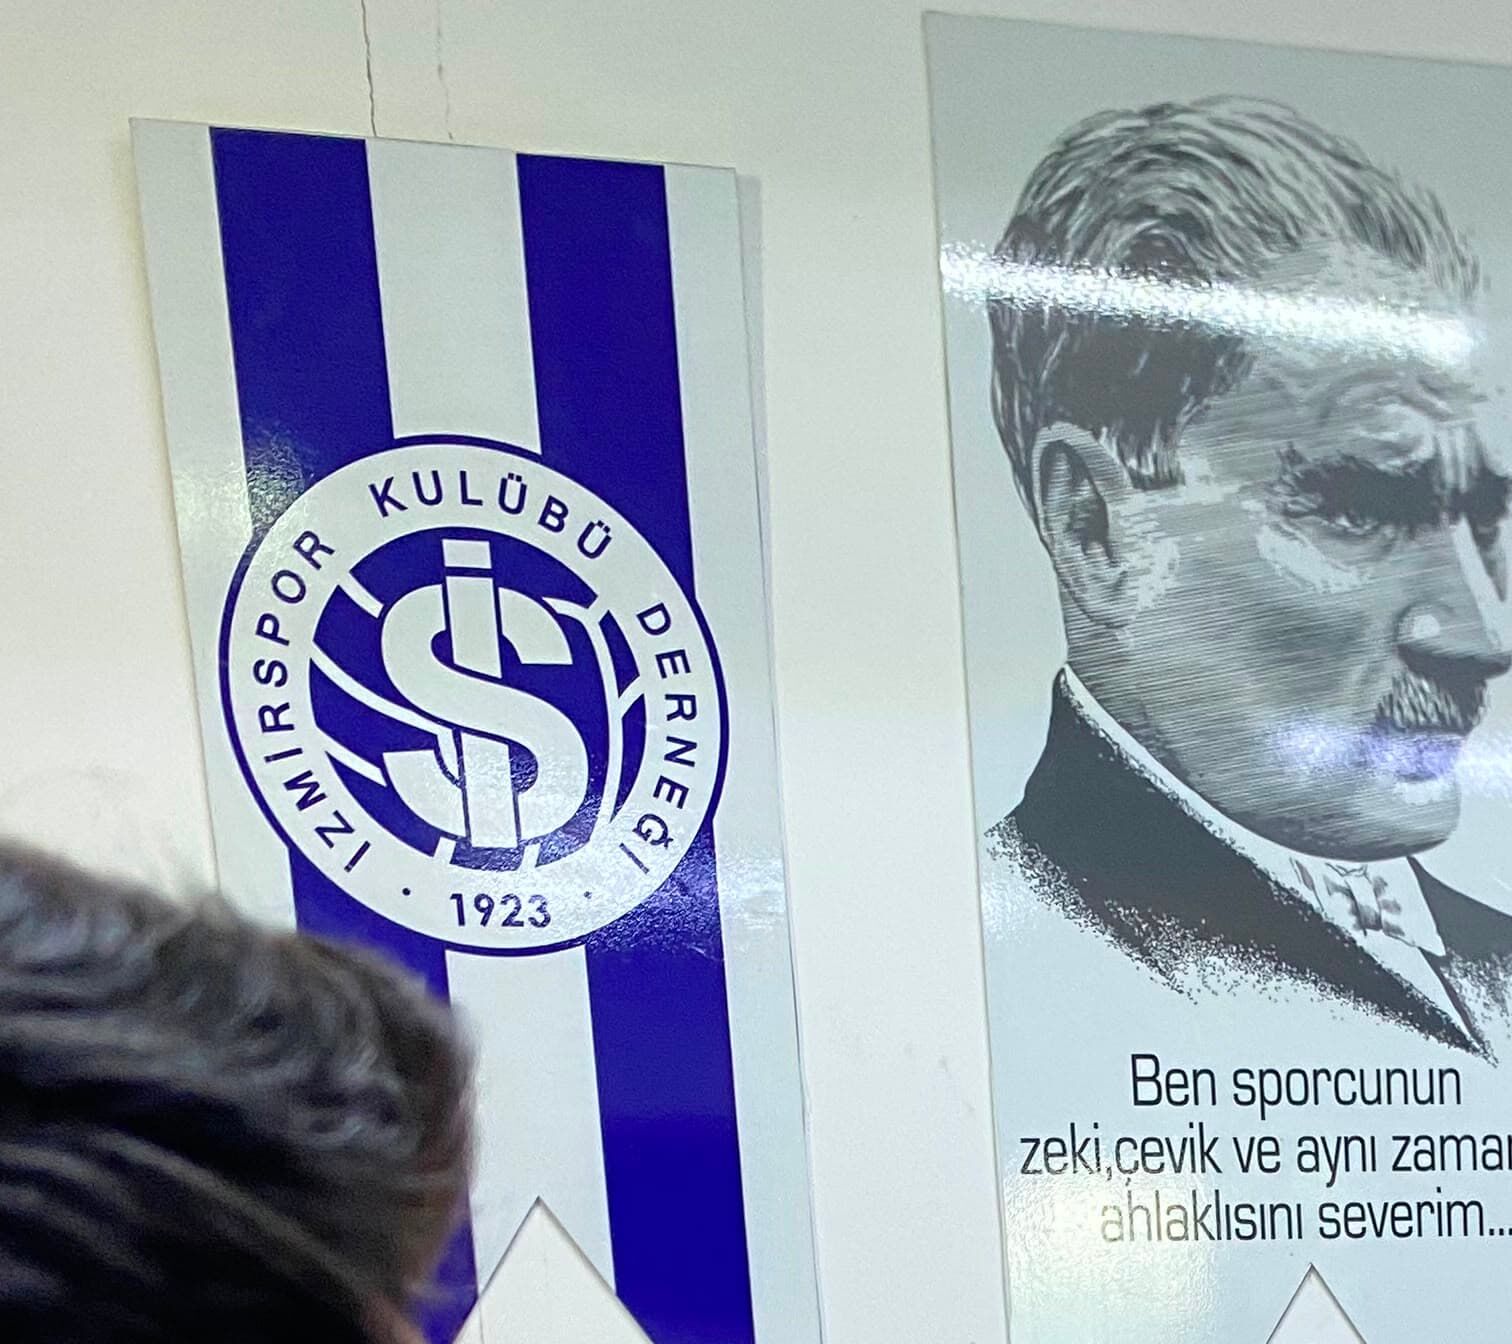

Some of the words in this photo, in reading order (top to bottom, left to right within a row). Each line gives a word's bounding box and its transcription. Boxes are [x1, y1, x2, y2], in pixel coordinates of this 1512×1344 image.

[369, 469, 613, 561] KULÜBÜ
[449, 893, 553, 929] 1923
[1131, 1053, 1217, 1106] Ben
[1232, 1066, 1462, 1120] sporcunun
[1233, 1136, 1281, 1174] ve
[1296, 1132, 1377, 1188] aynı
[1100, 1189, 1303, 1242] ahlaklısını
